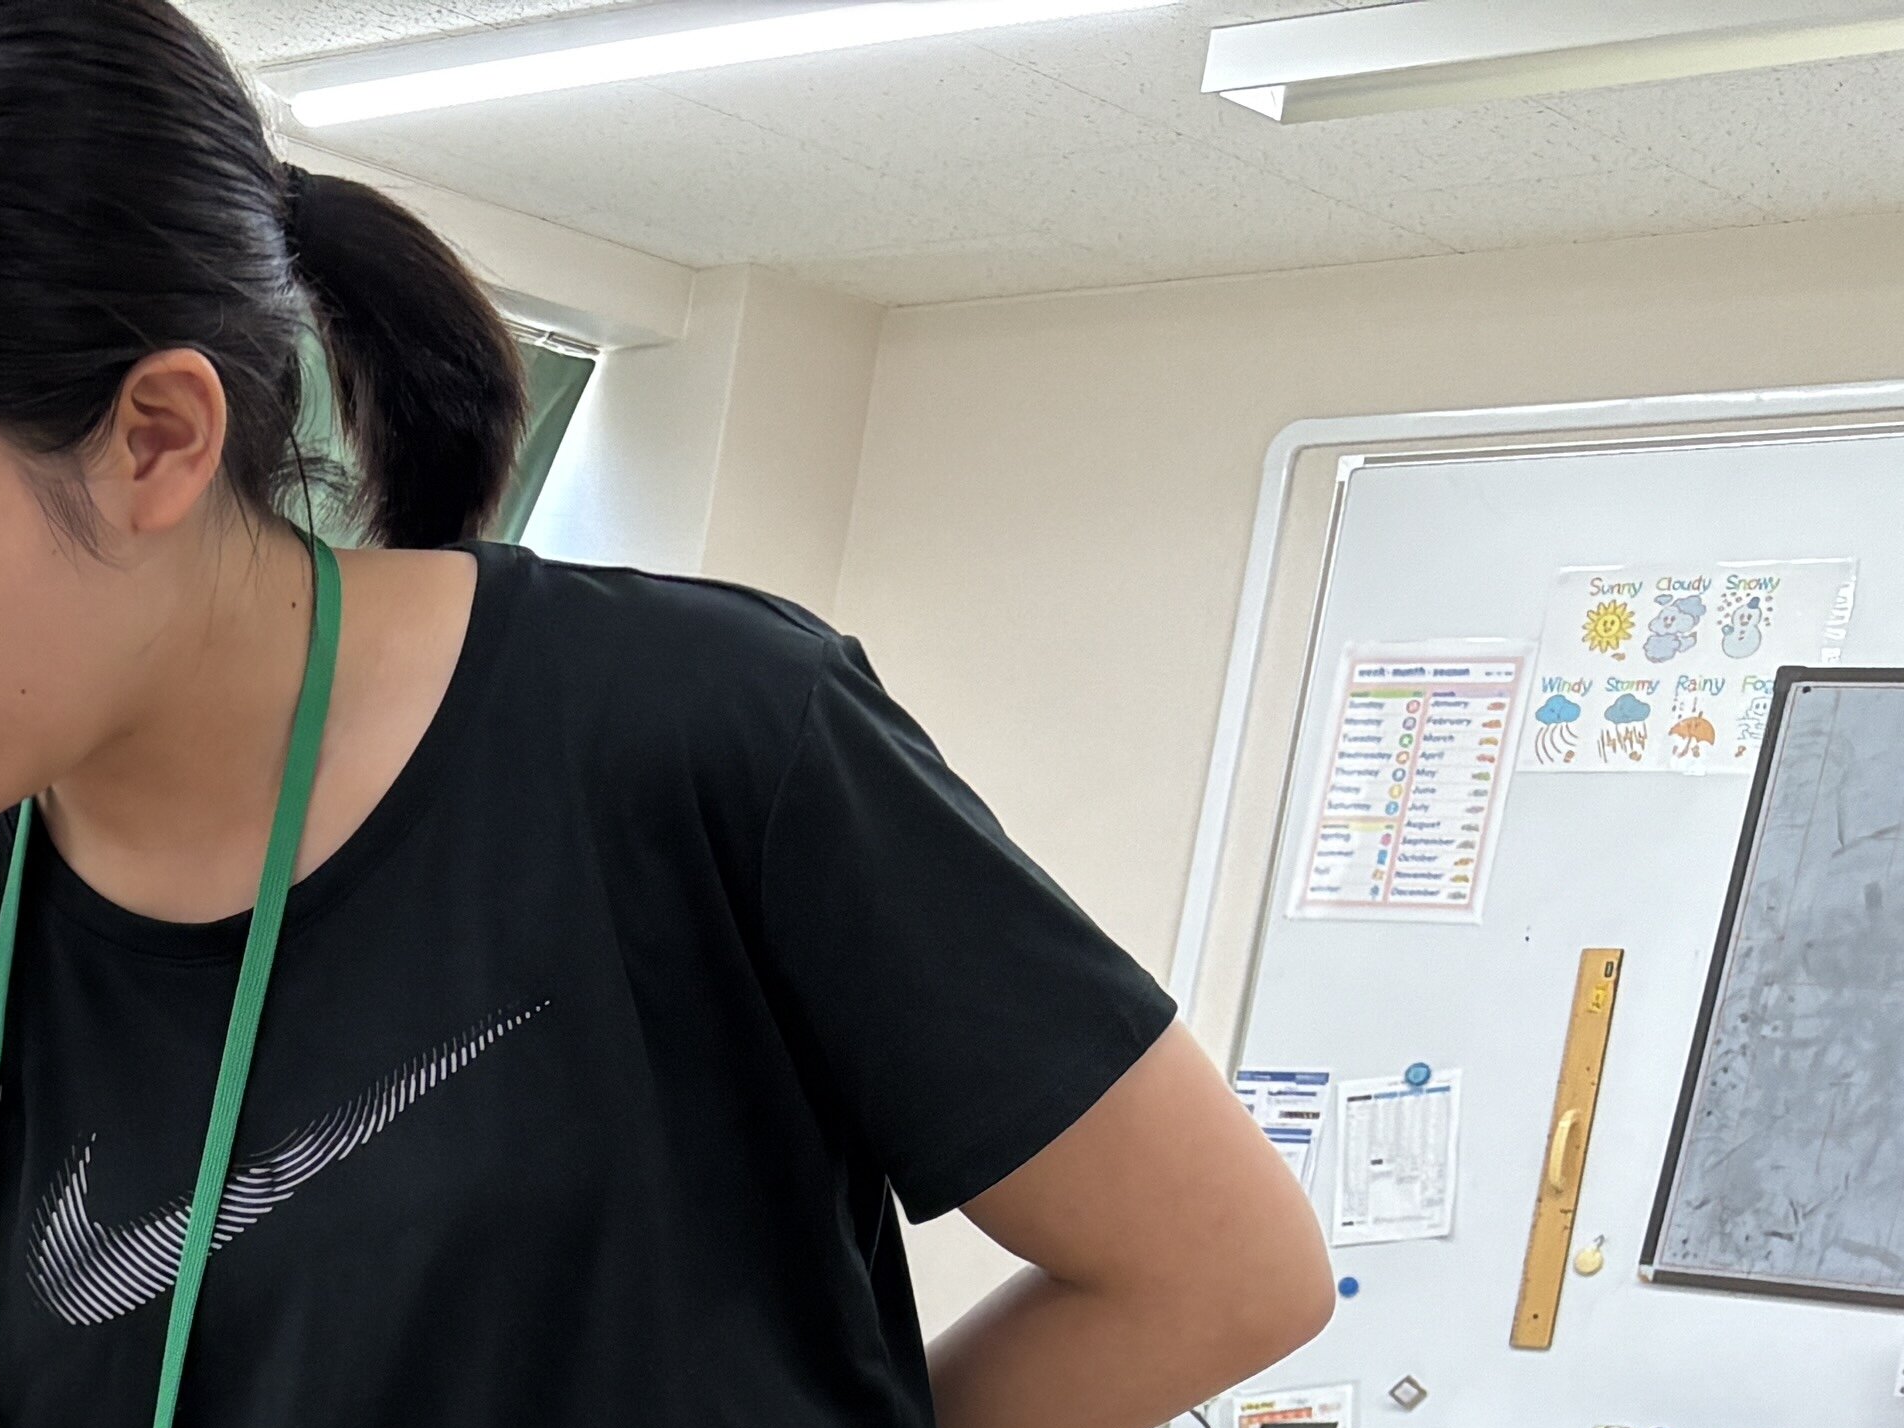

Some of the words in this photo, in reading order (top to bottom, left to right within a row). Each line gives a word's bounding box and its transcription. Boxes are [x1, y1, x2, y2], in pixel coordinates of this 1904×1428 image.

[1589, 576, 1643, 599] Sunny
[1655, 575, 1712, 593] Cloudy
[1726, 575, 1781, 592] Snowy
[1542, 676, 1593, 695] Windy
[1605, 676, 1660, 695] Stormy
[1676, 674, 1725, 695] Rainy
